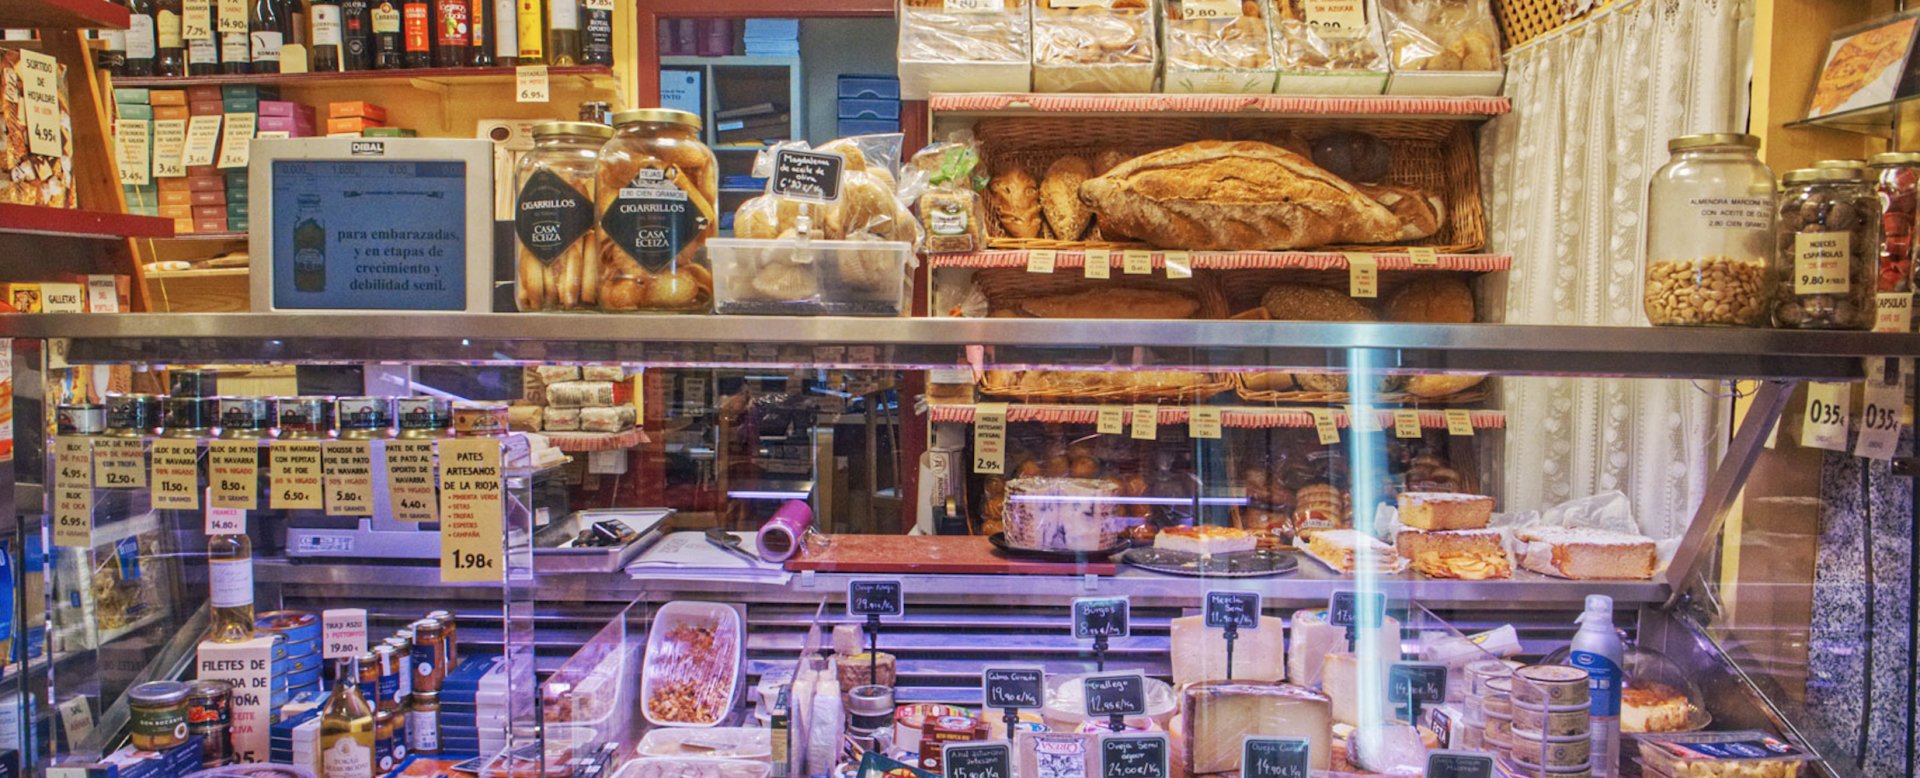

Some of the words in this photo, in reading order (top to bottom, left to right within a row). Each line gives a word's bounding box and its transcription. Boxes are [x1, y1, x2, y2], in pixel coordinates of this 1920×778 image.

[1185, 9, 1217, 17] 9.80
[352, 142, 383, 152] DIBAL
[640, 169, 663, 178] TEJAS
[655, 191, 686, 199] GRAMOS
[620, 204, 686, 214] CIGARRILLOS
[534, 224, 557, 234] CASA
[338, 230, 367, 243] para
[532, 233, 562, 242] ECEIZA
[638, 230, 665, 239] CASA
[635, 238, 669, 248] ECEIZA
[354, 249, 360, 259] y
[365, 248, 380, 257] en
[384, 247, 425, 259] etapas
[428, 246, 444, 257] de
[356, 262, 431, 274] crecimiento
[434, 265, 441, 276] y
[350, 279, 410, 291] debilidad
[414, 279, 447, 291] senil.
[1802, 275, 1824, 285] 9.80
[48, 294, 77, 304] GALLETAS
[456, 452, 484, 461] PATES
[977, 458, 1000, 470] 2.95€
[62, 467, 81, 478] 4.95
[446, 467, 496, 476] ARTESANOS
[106, 473, 130, 484] 12.50
[395, 476, 426, 484] NAVARRA
[161, 481, 182, 491] 11.50
[221, 480, 240, 490] 8.50
[444, 482, 455, 490] DE
[459, 482, 471, 490] LA
[475, 481, 499, 491] RIOJA
[284, 490, 304, 501] 6.50
[336, 490, 356, 501] 5.80
[401, 499, 421, 509] 4.40
[61, 515, 80, 526] 6.95
[212, 521, 233, 529] 14.80
[452, 549, 493, 569] 1.98€
[1083, 606, 1116, 618] Burgos
[330, 643, 354, 653] 19.80
[202, 660, 244, 671] FILETES
[250, 659, 265, 670] DE
[252, 678, 267, 687] DE
[1107, 741, 1131, 753] Oveja
[1137, 740, 1158, 750] Semi
